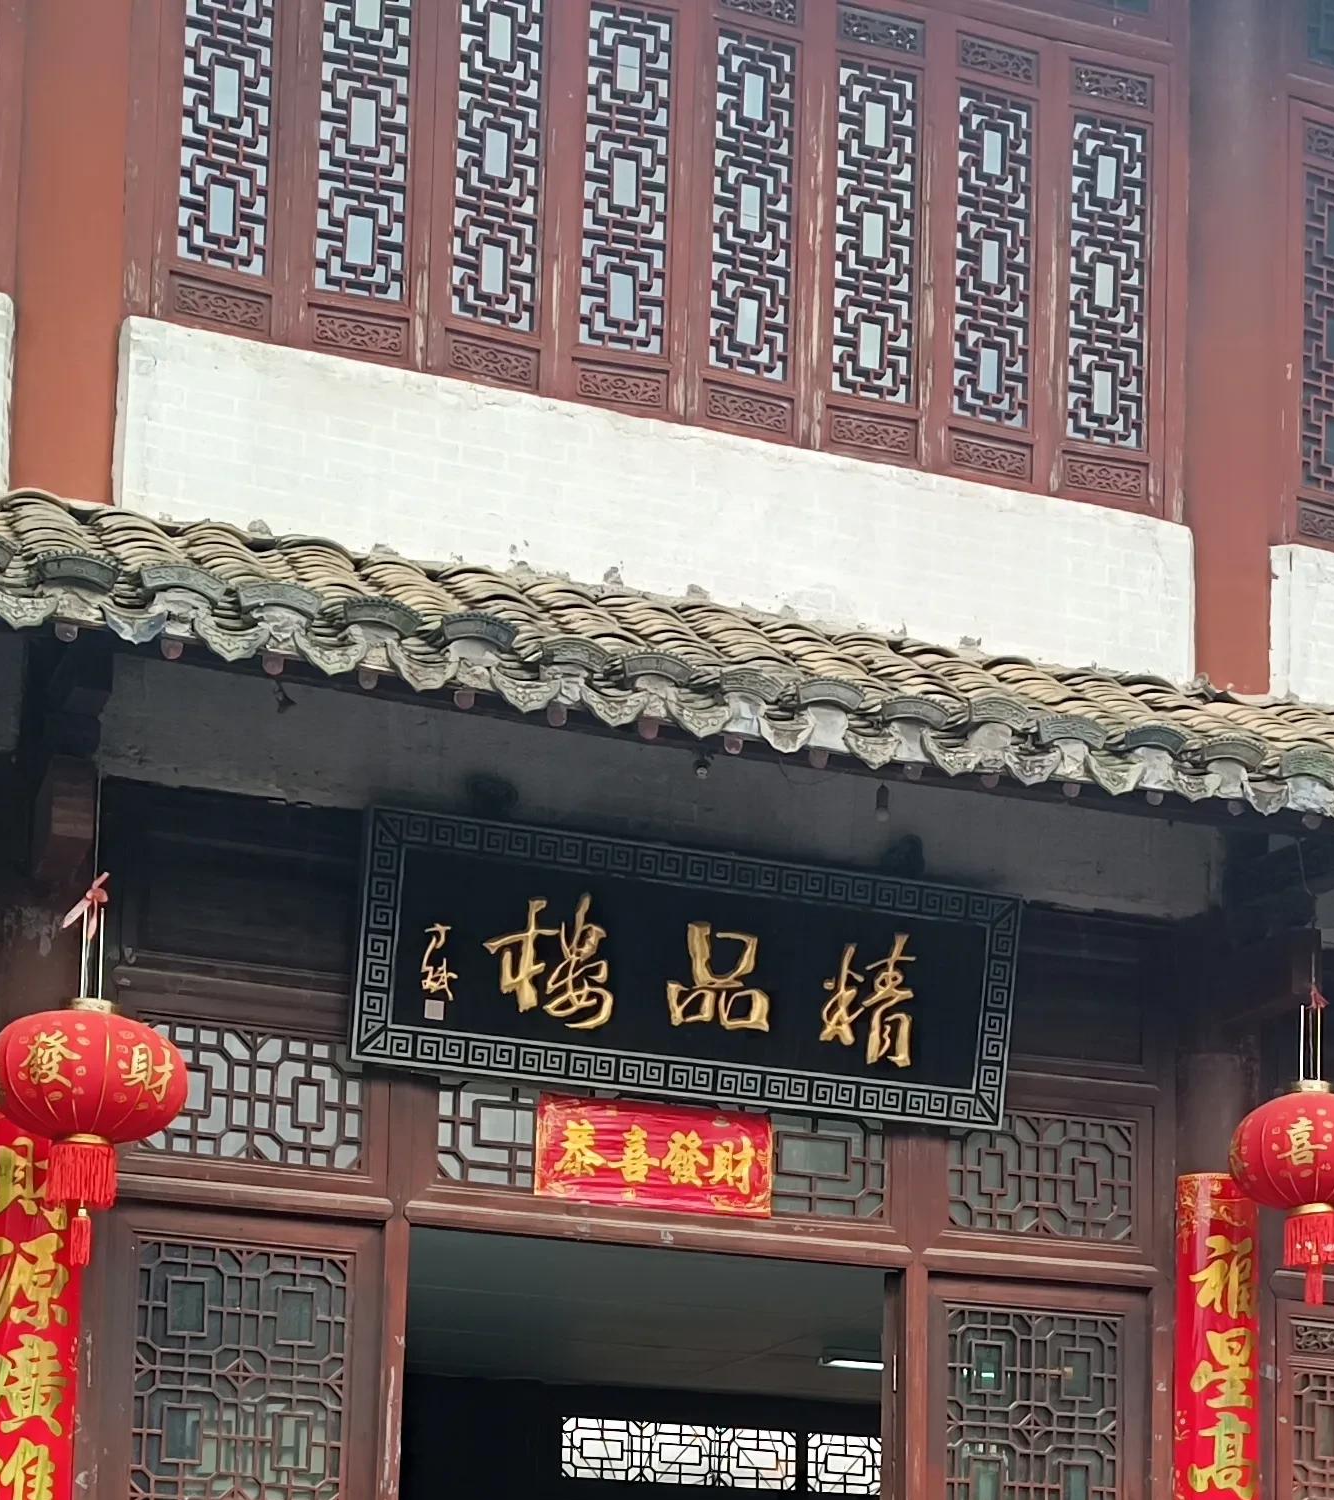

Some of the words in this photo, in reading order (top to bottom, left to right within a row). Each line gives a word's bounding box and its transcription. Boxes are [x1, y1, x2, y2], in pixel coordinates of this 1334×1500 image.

[553, 1119, 759, 1195] 恭喜發財
[1276, 1116, 1329, 1166] 喜
